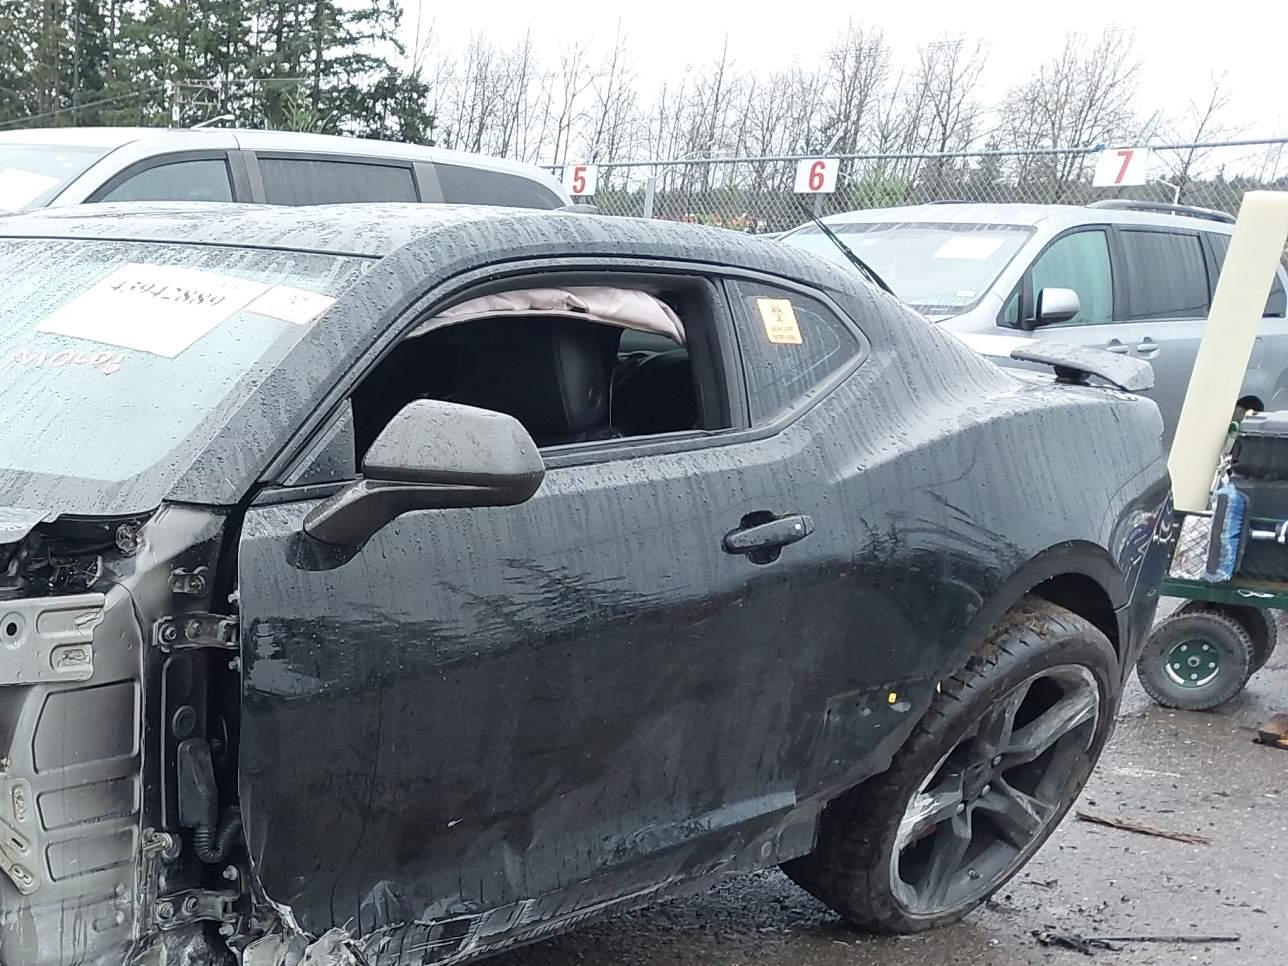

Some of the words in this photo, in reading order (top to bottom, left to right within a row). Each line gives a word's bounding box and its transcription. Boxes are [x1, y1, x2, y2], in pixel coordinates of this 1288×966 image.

[572, 167, 587, 194] 5
[808, 161, 826, 192] 6
[1114, 150, 1135, 184] 7
